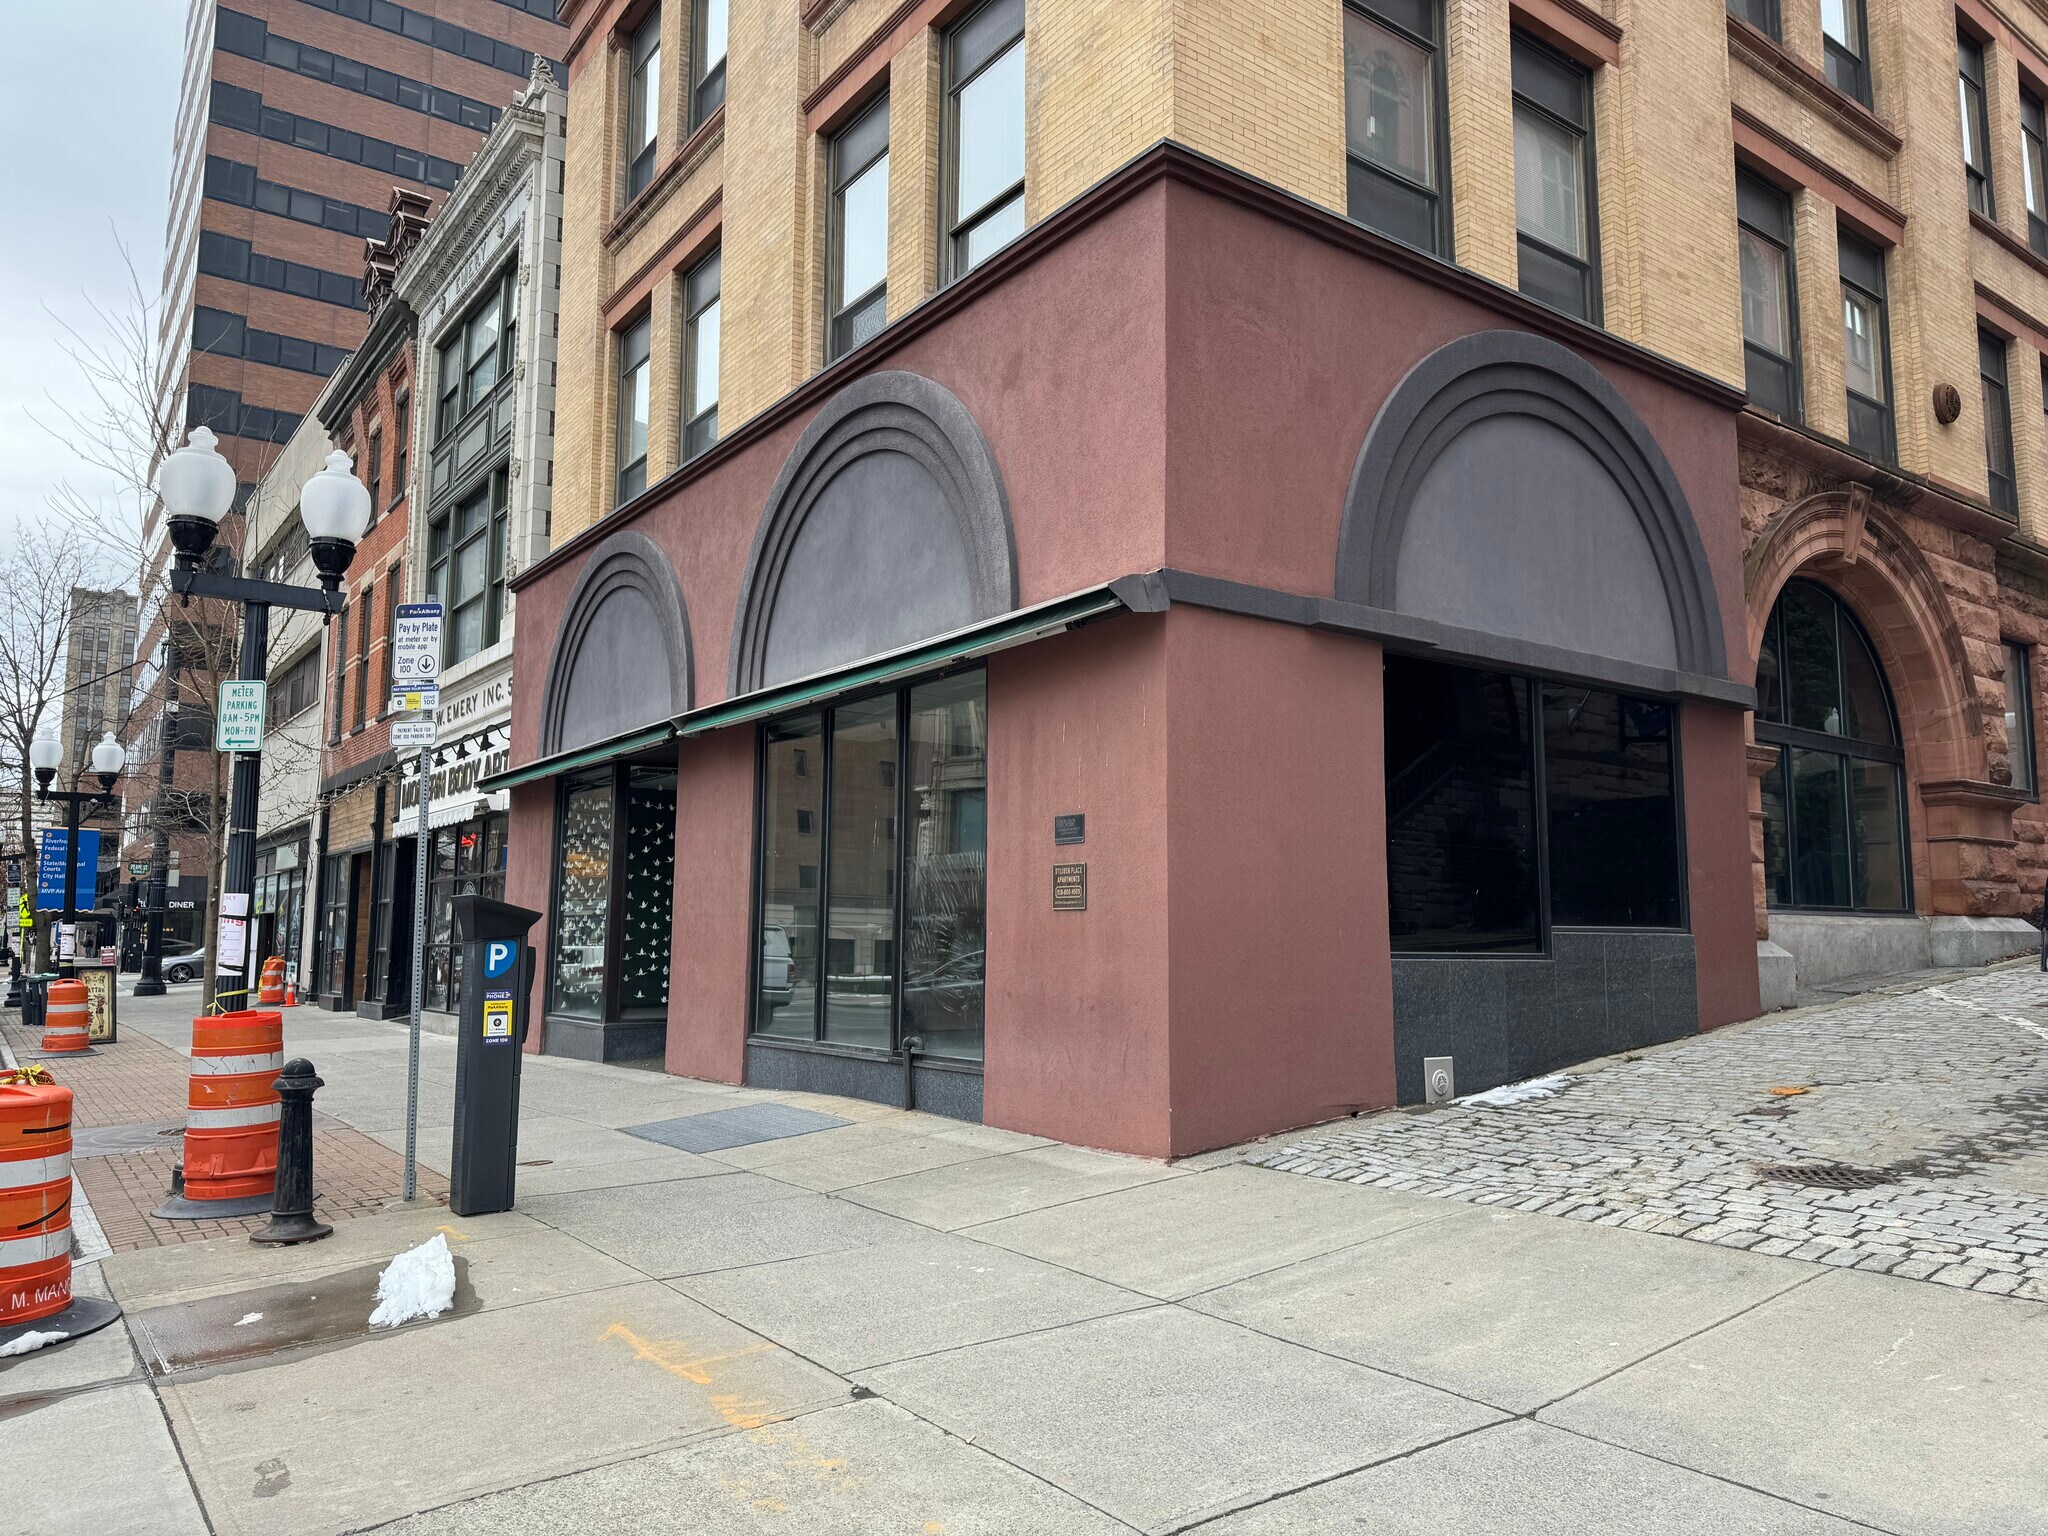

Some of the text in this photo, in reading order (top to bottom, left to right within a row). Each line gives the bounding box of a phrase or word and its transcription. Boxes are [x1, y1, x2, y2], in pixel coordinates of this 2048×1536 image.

[456, 241, 487, 295] EMERY
[398, 622, 438, 635] Pay by Plate
[398, 657, 414, 665] Zone
[400, 665, 411, 674] 100
[232, 688, 254, 697] METER
[227, 700, 257, 710] PARKING
[447, 693, 478, 723] EMERY
[483, 682, 504, 708] INC.
[244, 712, 260, 722] 5PM
[224, 726, 256, 735] MON-FRI
[401, 749, 510, 810] MORN BODY ART
[168, 901, 195, 909] DINER
[489, 943, 508, 971] P
[11, 1291, 30, 1310] M.
